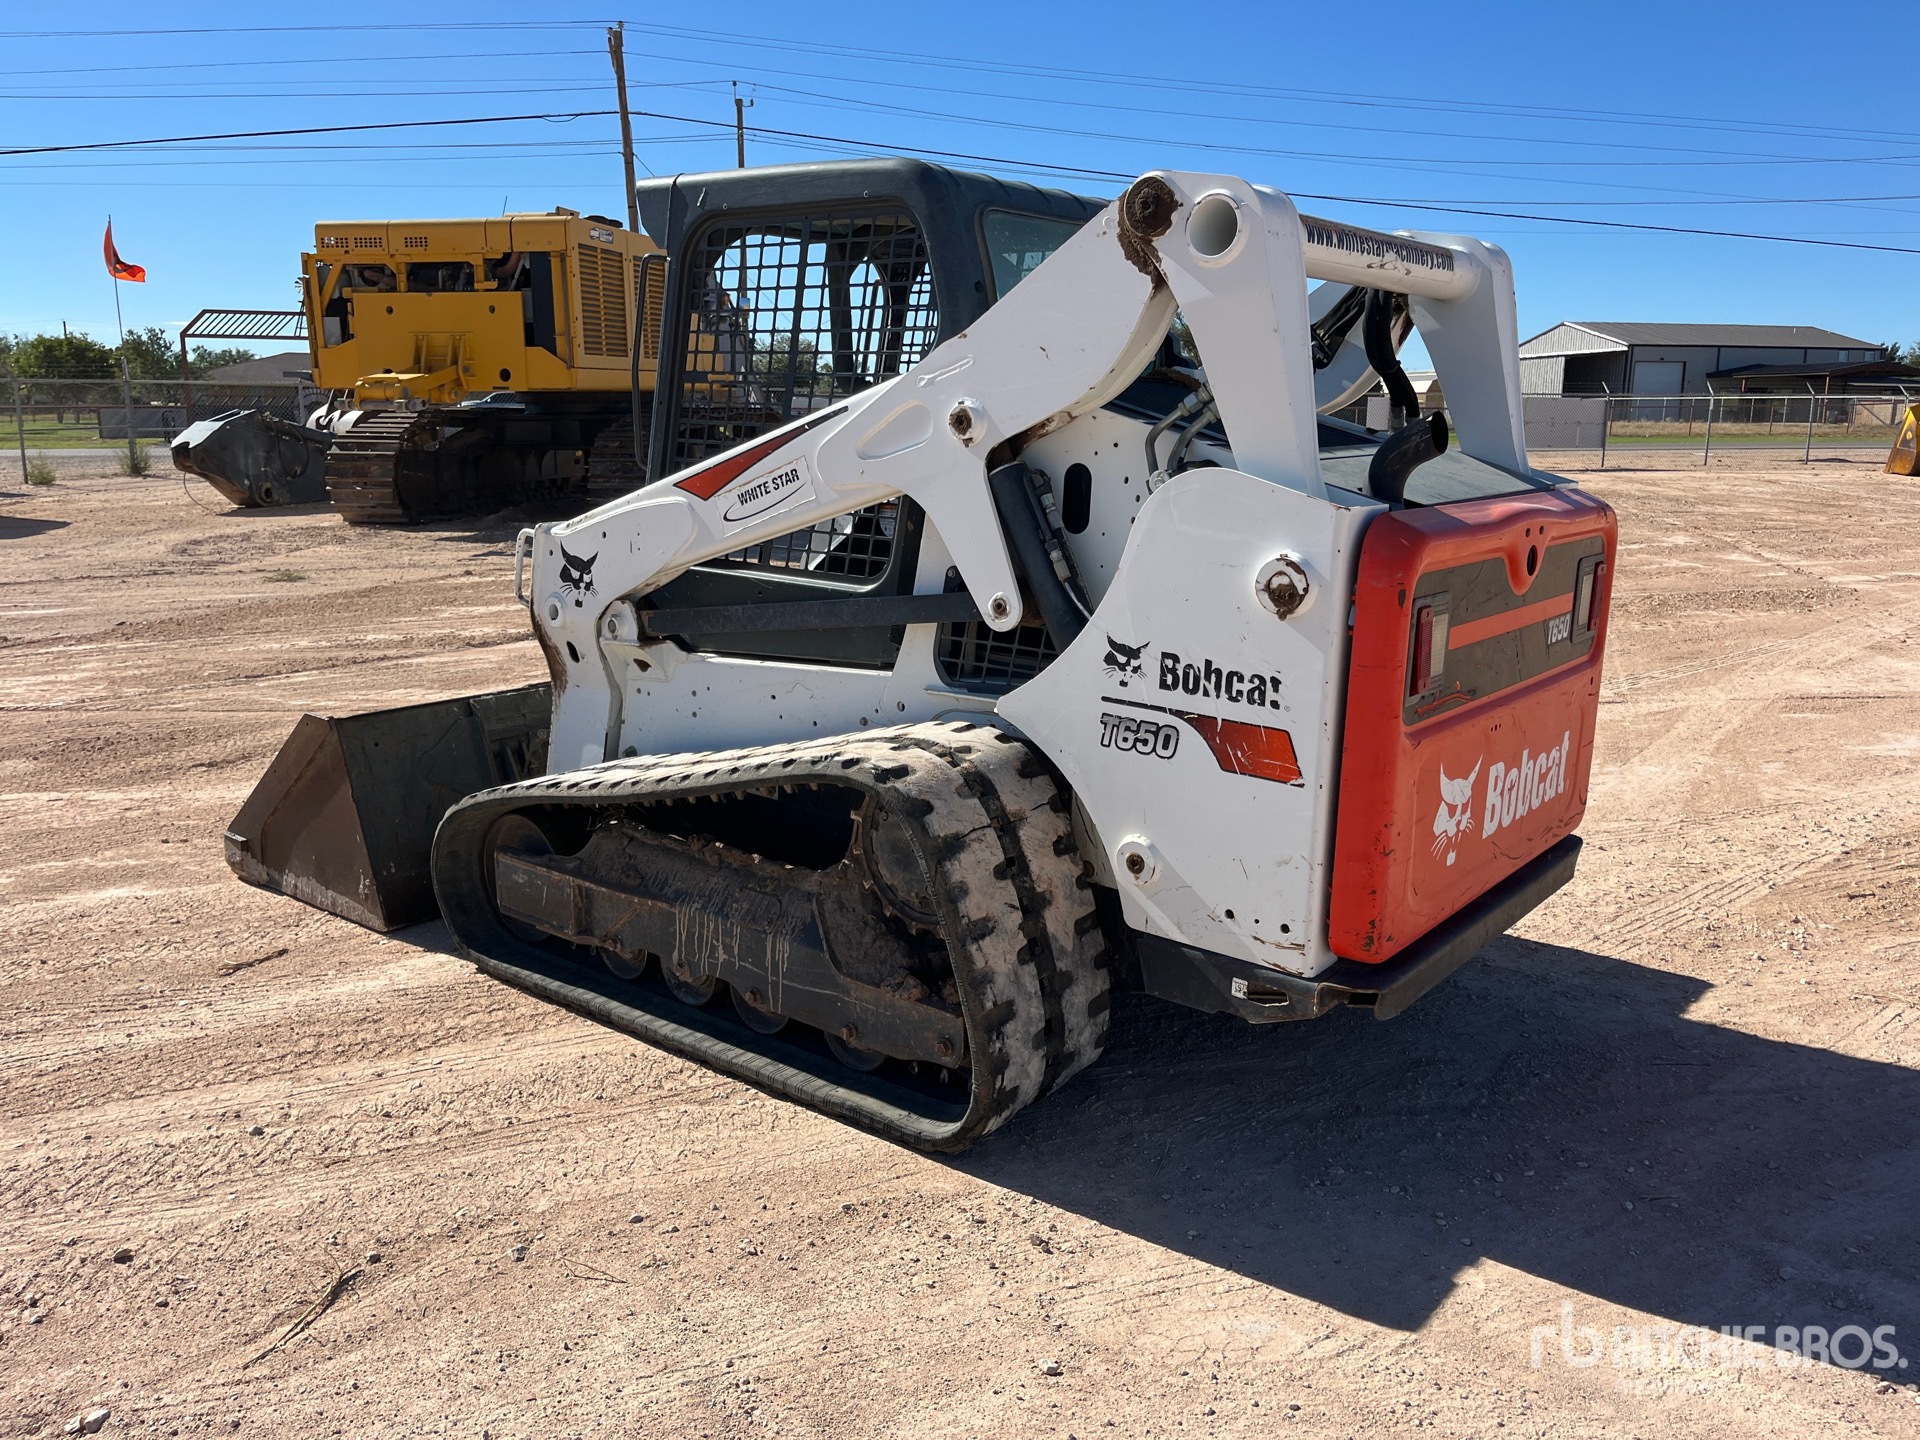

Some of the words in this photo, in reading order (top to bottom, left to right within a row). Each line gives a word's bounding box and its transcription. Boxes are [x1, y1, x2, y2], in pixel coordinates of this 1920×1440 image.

[736, 481, 771, 506] WHITE
[771, 468, 800, 490] STAR
[1547, 614, 1570, 645] T650
[1158, 651, 1282, 711] Bobcat
[1100, 712, 1180, 759] T650
[1482, 730, 1570, 840] Bobcat
